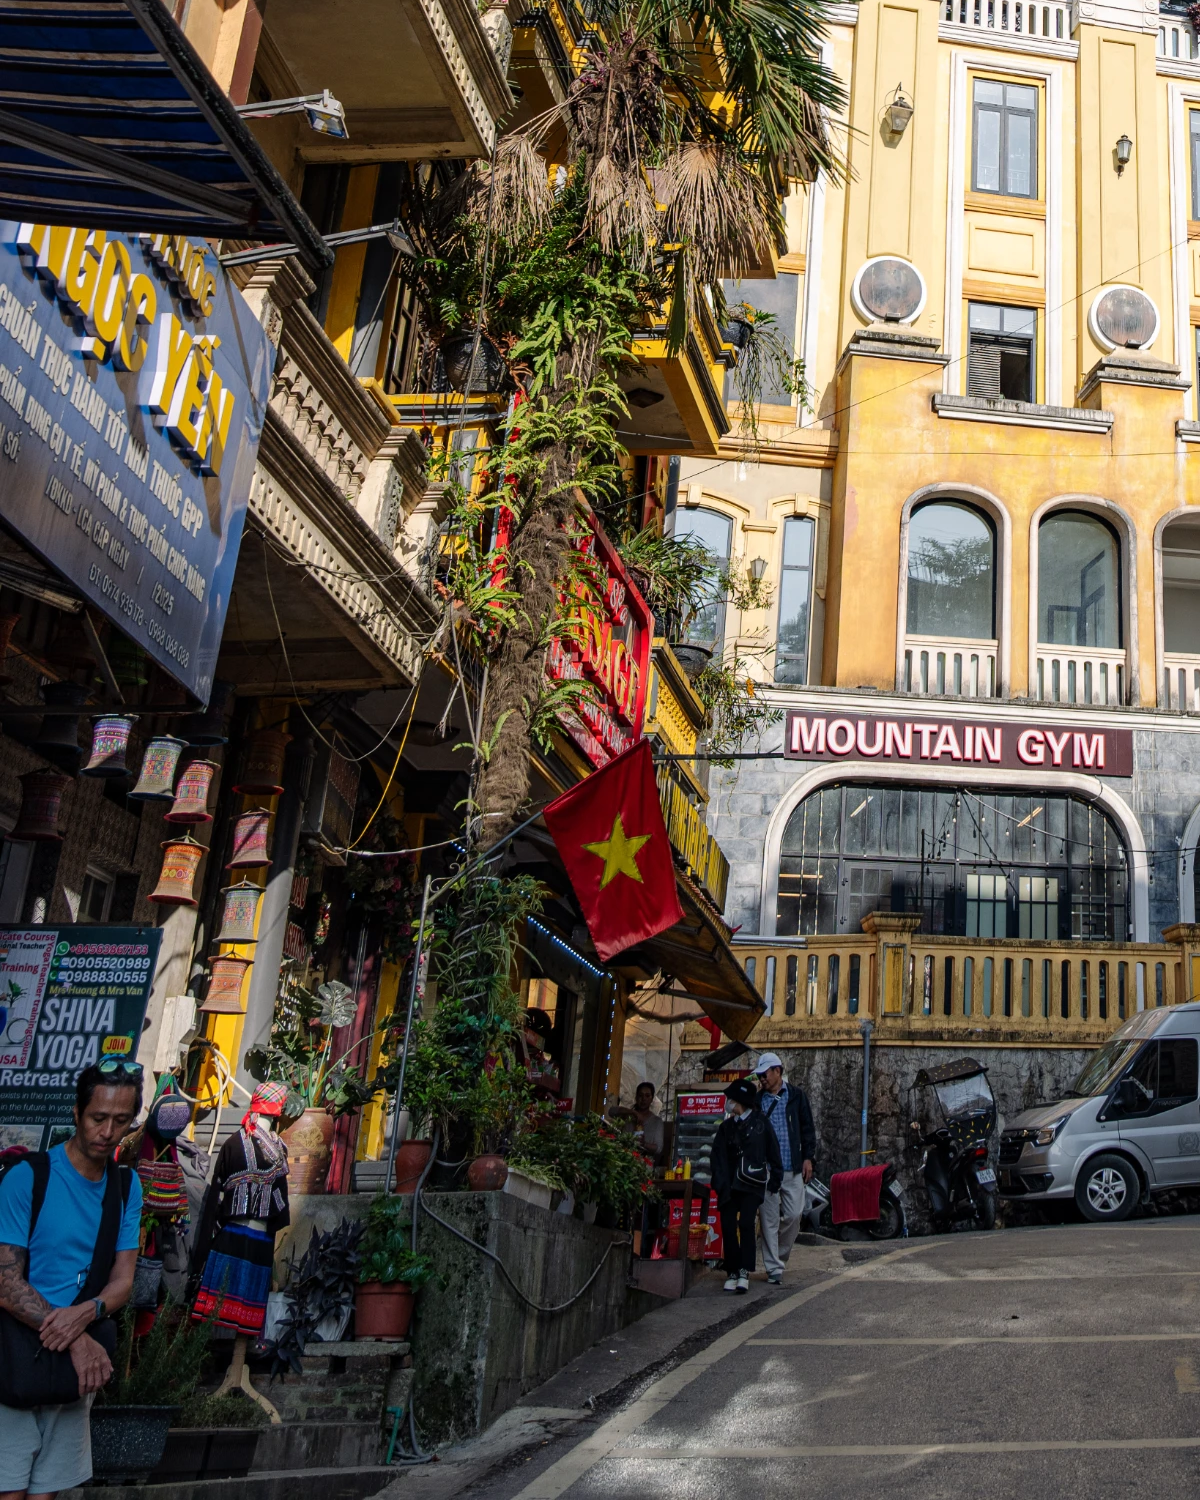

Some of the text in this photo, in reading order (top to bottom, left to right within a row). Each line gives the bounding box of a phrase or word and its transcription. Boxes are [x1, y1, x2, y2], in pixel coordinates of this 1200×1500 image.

[70, 372, 107, 435] HÀNH
[103, 408, 128, 456] TỐT
[149, 459, 184, 520] THUỐC
[181, 497, 204, 539] GPP
[76, 503, 93, 538] LCA
[91, 519, 111, 551] CẤP
[107, 535, 131, 573] NGÀY
[789, 716, 1107, 769] MOUNTAIN GYM
[23, 932, 56, 941] Course
[19, 942, 46, 950] Teacher
[1, 963, 40, 975] Training
[68, 957, 151, 969] 0905520989
[65, 971, 147, 983] 0988830555
[49, 985, 66, 995] Mrs
[67, 986, 98, 997] Huong
[107, 986, 124, 996] Mrs
[126, 986, 143, 996] Van
[41, 998, 116, 1032] SHIVA
[106, 1039, 126, 1051] JOIN
[36, 1035, 99, 1069] YOGA
[0, 1069, 70, 1088] Retreat
[0, 1092, 20, 1100] exists
[30, 1092, 43, 1100] the
[44, 1093, 62, 1102] past
[9, 1102, 21, 1111] the
